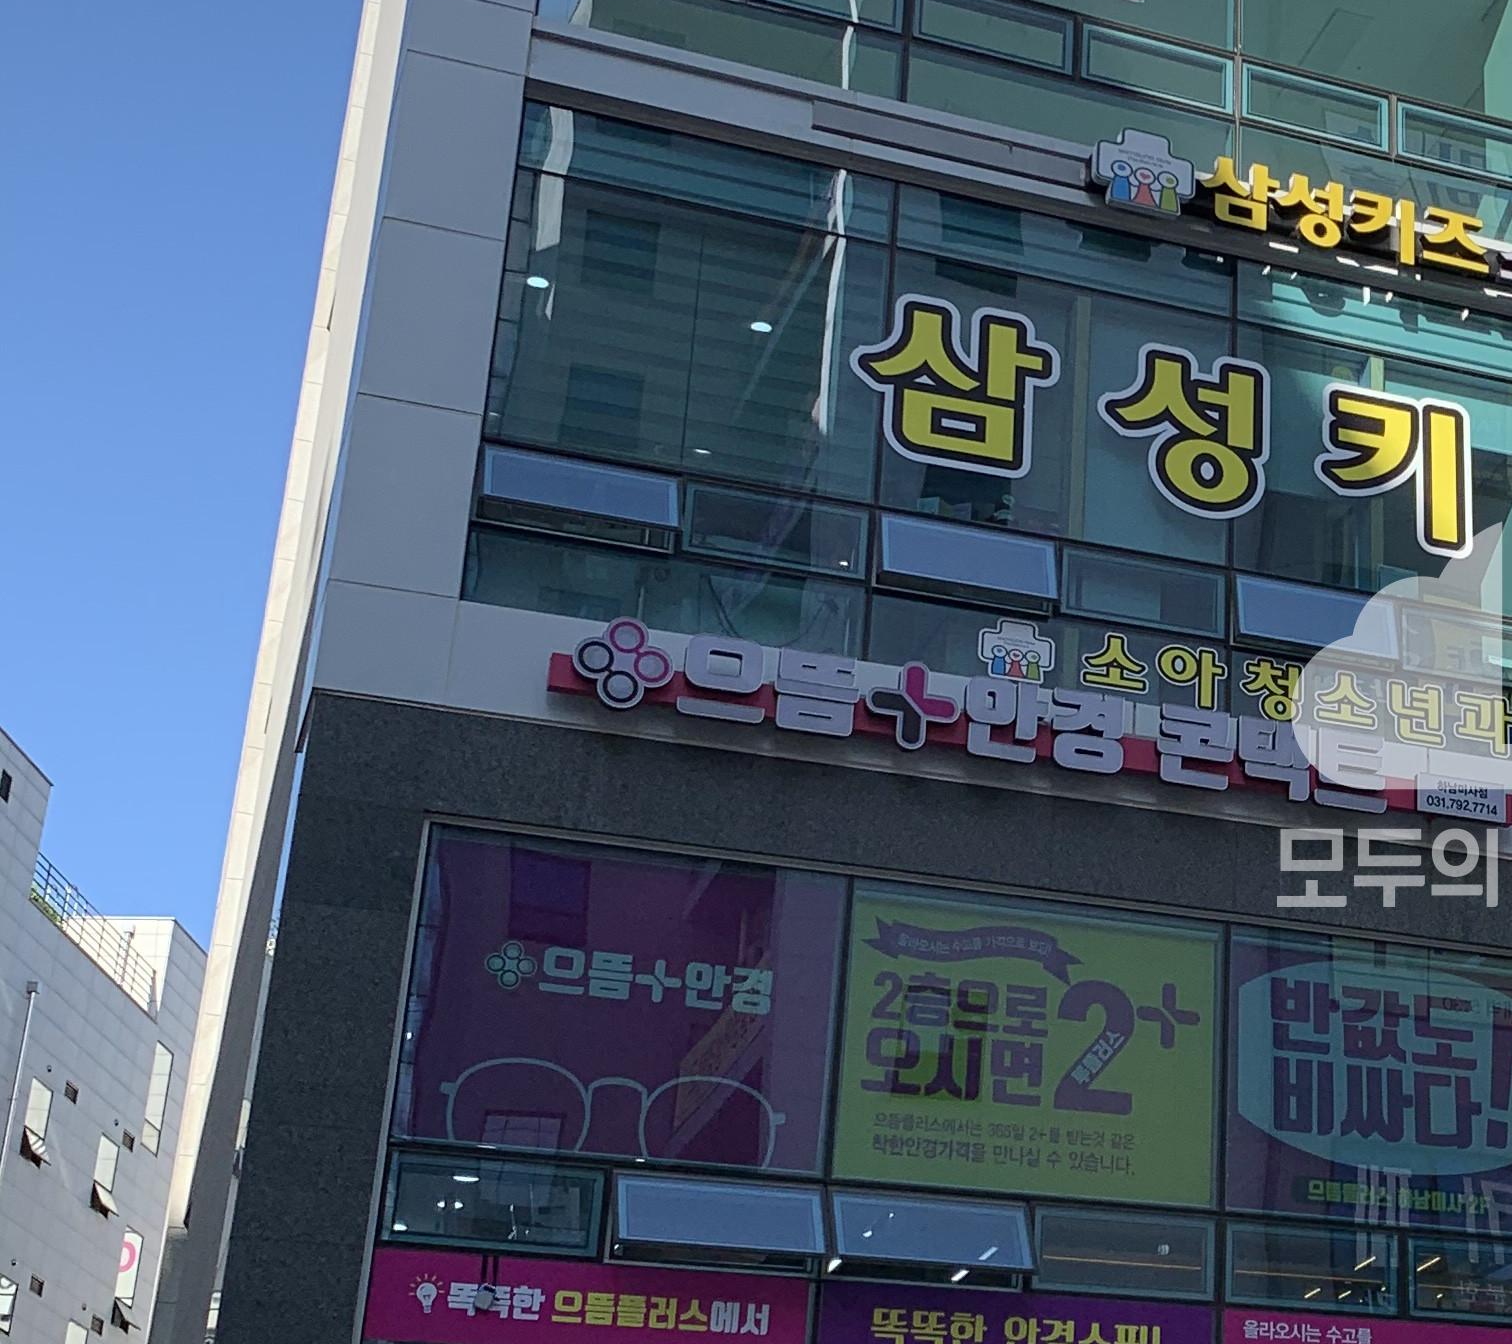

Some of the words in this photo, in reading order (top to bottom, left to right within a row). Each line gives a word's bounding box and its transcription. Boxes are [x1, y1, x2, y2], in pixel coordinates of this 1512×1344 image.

[1426, 794, 1498, 816] 031.792.7714
[872, 971, 1048, 1038] 2층으로
[1270, 976, 1478, 1072] 반값도
[860, 1027, 1045, 1107] 오시면
[992, 1143, 1041, 1168] 만나실
[1047, 1146, 1063, 1169] 수
[1242, 1319, 1321, 1344] 올라오시는
